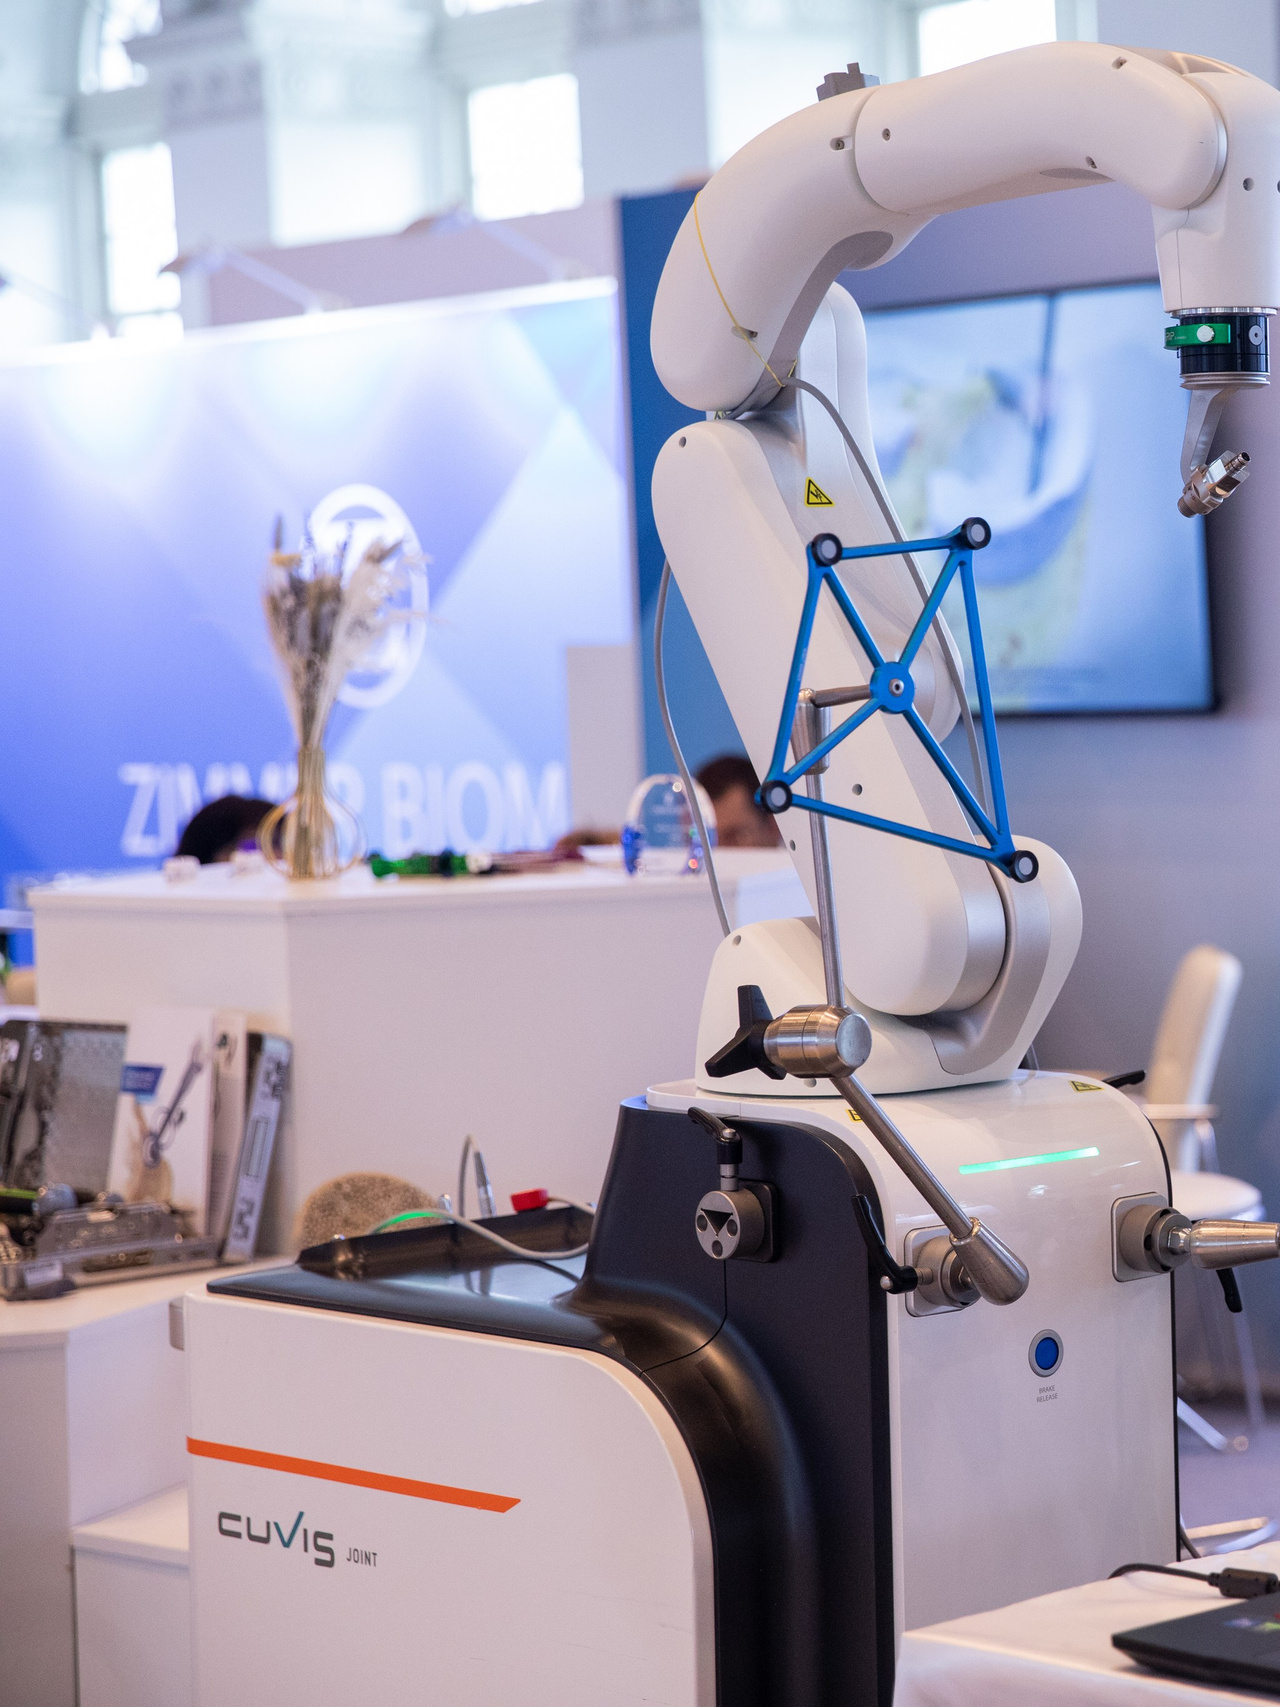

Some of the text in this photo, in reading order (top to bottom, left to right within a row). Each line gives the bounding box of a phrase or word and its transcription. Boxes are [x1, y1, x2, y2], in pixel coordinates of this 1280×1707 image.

[1039, 1385, 1056, 1394] BRAKE
[1037, 1393, 1059, 1403] RELEASE
[218, 1511, 378, 1568] CUVIS JOINT
